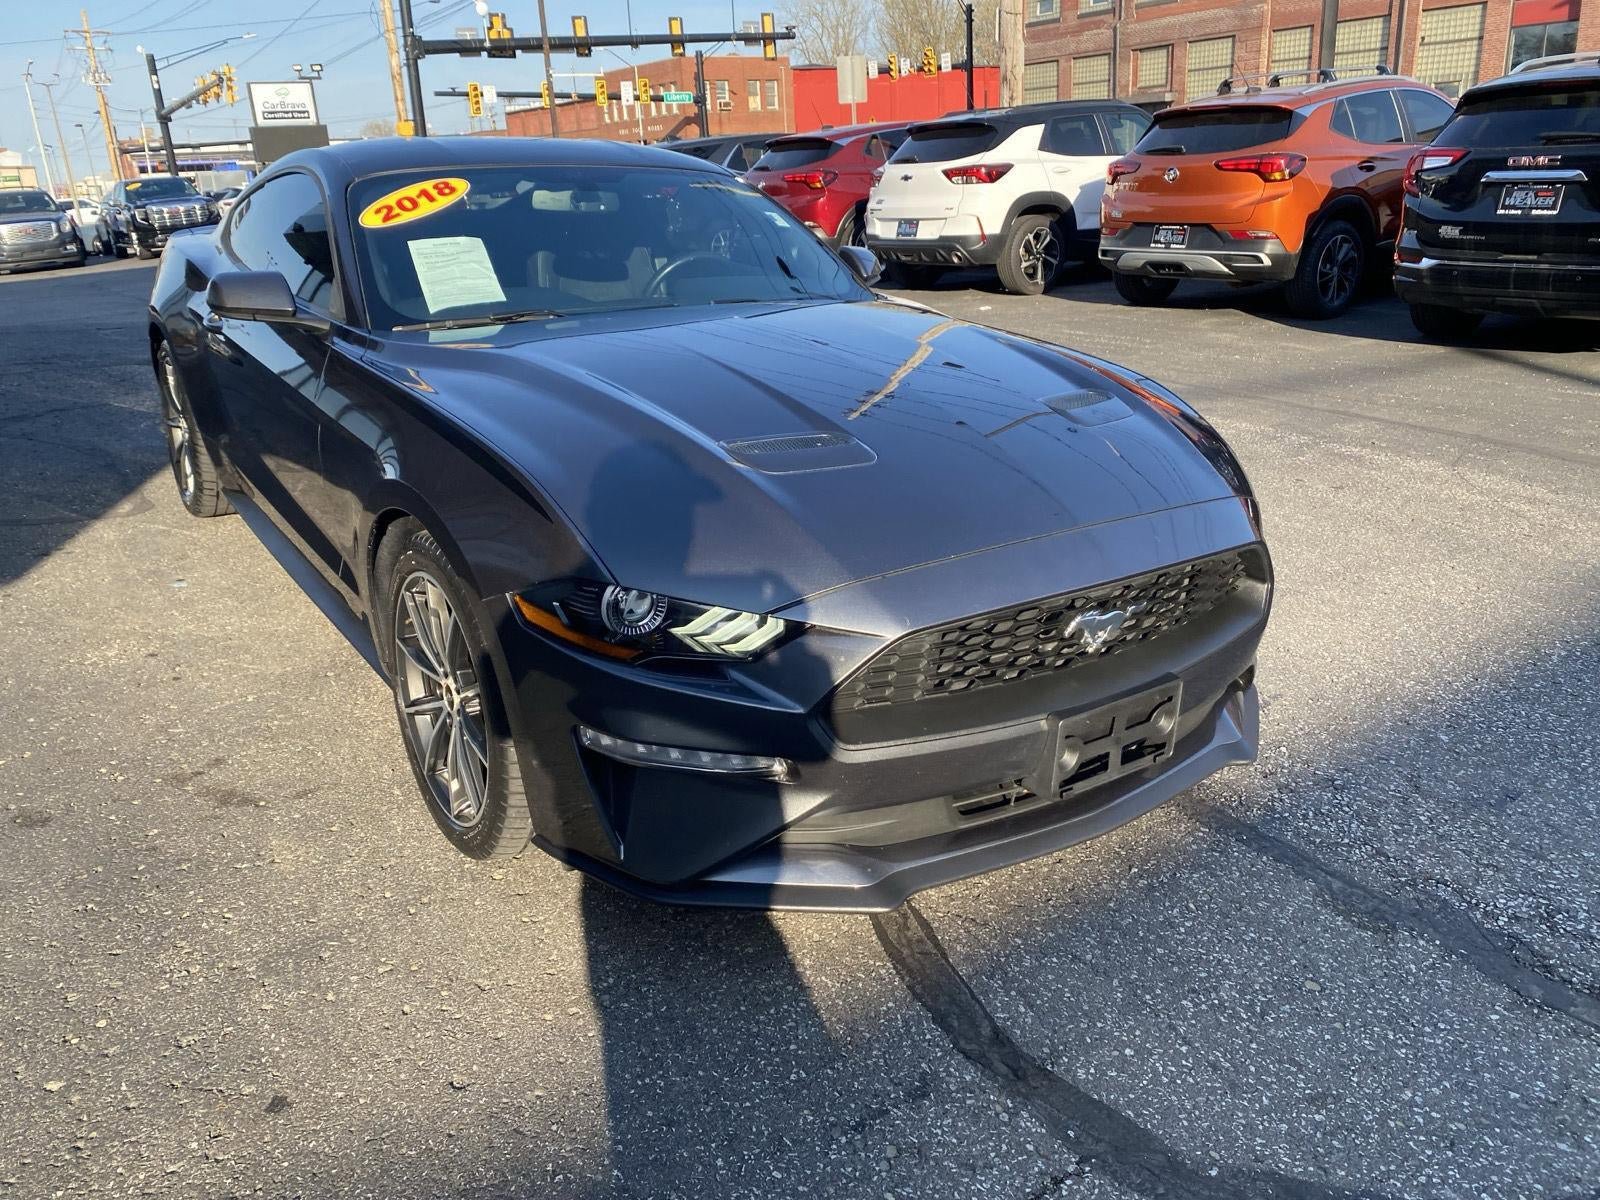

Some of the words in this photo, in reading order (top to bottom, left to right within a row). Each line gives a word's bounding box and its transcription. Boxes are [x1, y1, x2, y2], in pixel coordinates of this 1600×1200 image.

[667, 93, 690, 102] Liberty
[262, 100, 307, 109] CarBravo
[1507, 154, 1561, 166] GMC
[374, 180, 457, 224] 2018
[1504, 196, 1556, 206] WEAVER
